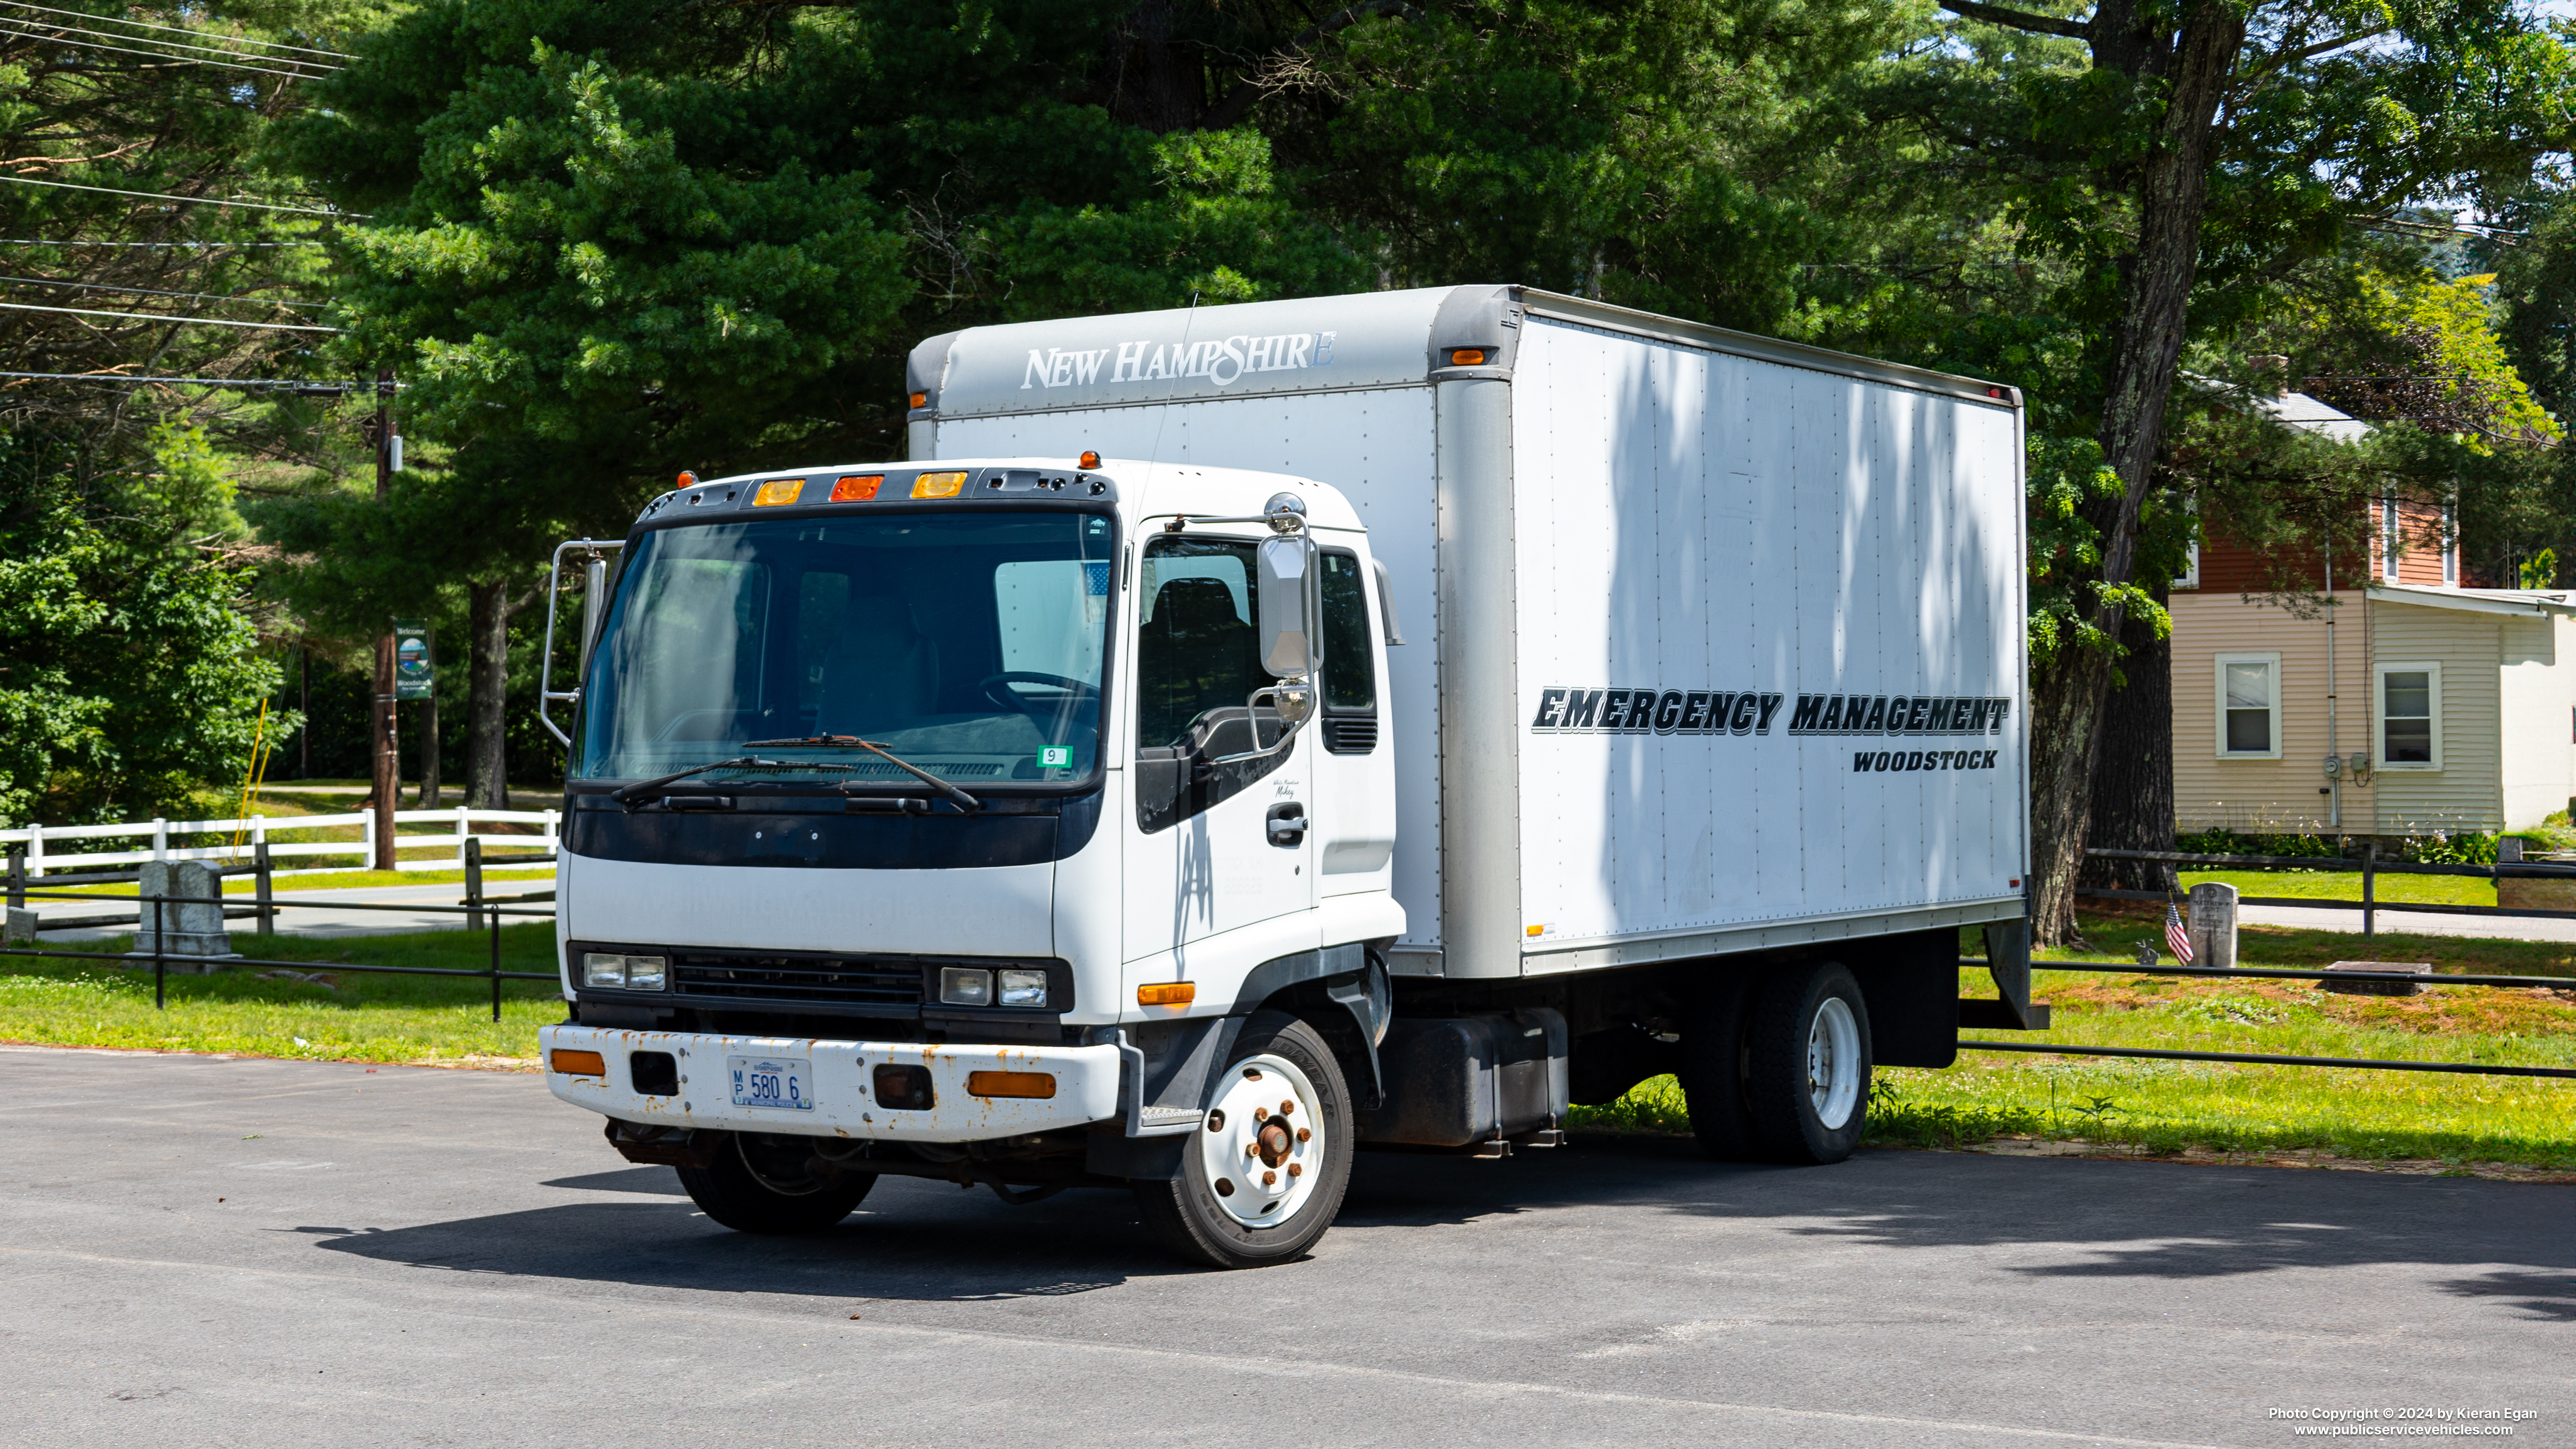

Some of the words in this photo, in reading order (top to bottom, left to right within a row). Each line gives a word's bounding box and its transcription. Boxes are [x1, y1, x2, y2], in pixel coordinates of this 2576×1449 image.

[1020, 348, 1110, 389] NEW
[1110, 331, 1338, 386] HAMPSHIRE
[1531, 686, 1783, 735] EMERGENCY
[1788, 694, 2011, 735] MANAGEMENT
[1047, 750, 1056, 762] 9
[1853, 750, 1998, 772] WOODSTOCK
[751, 1074, 780, 1099] 580
